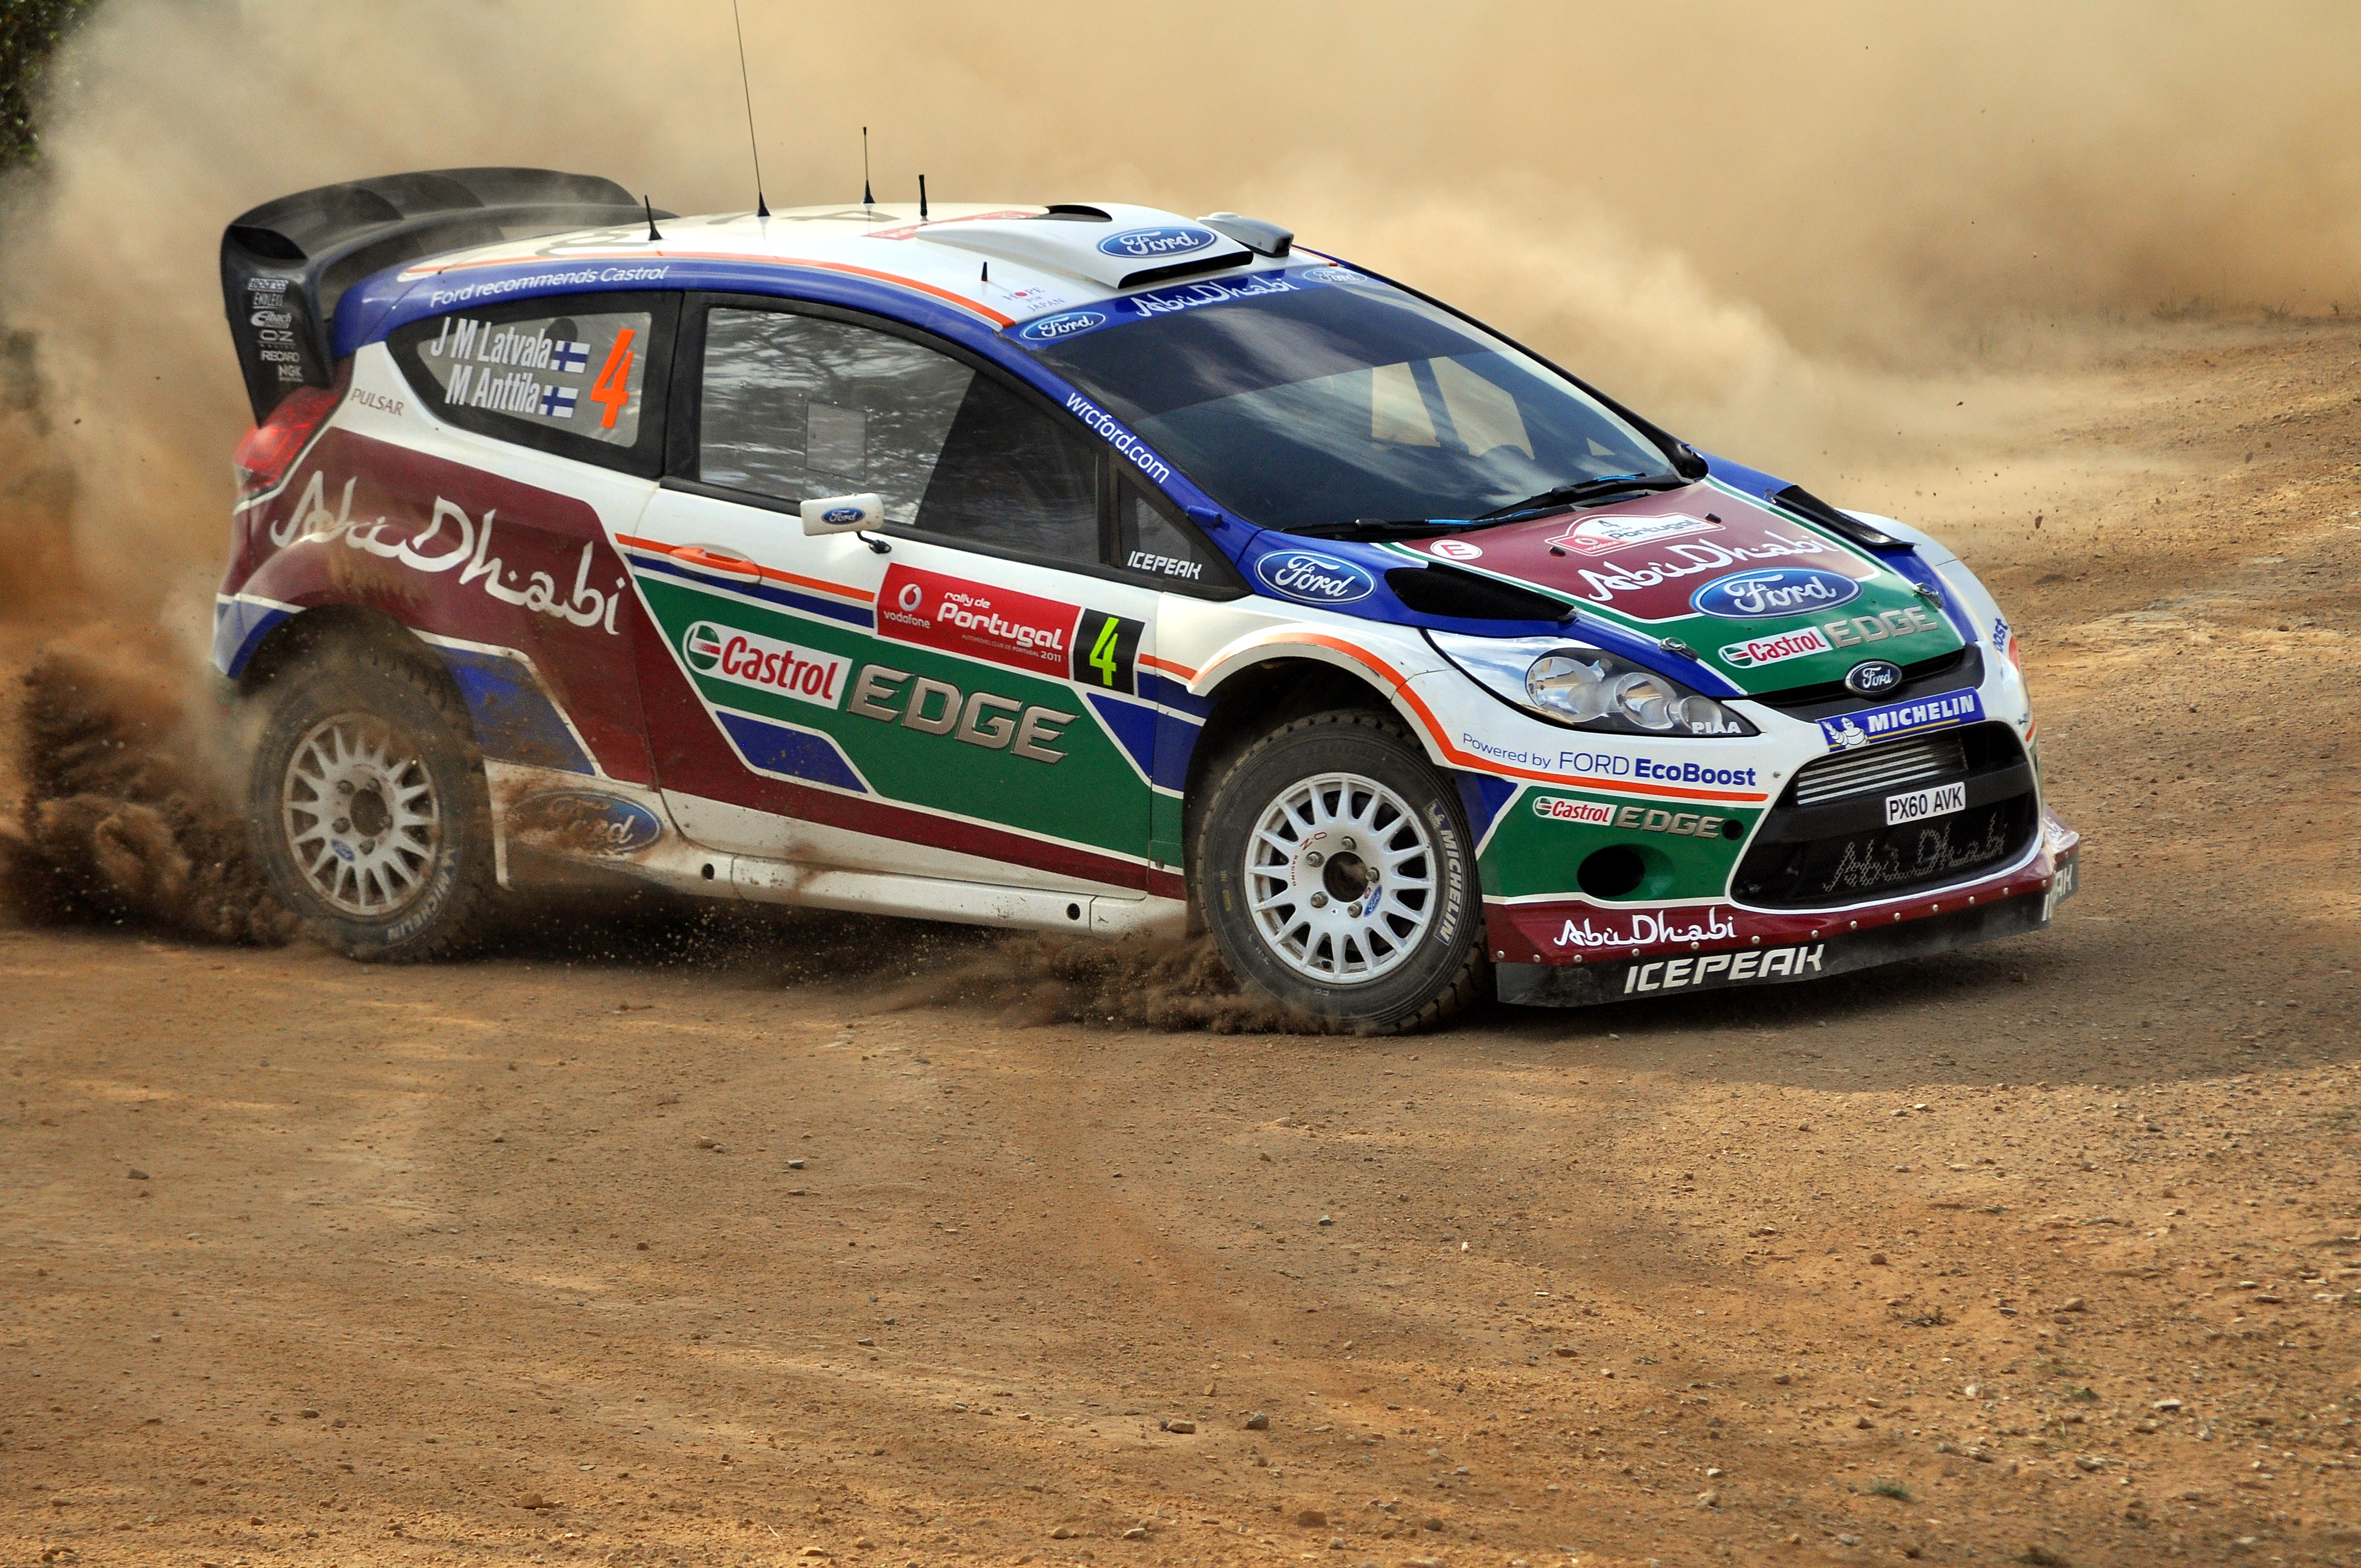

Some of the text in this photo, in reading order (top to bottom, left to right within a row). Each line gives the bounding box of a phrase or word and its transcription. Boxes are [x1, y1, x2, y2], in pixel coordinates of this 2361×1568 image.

[1118, 230, 1199, 255] Ford
[430, 265, 670, 308] Ford recommends Castrol
[1028, 297, 1065, 312] JAPAN
[431, 317, 553, 370] J M Latvala
[1037, 315, 1095, 337] Ford
[444, 363, 542, 414] M Anttila
[590, 328, 635, 429] 4
[350, 388, 405, 417] PULSAR
[1065, 392, 1170, 484] wrcford.com
[1598, 520, 1621, 528] 4
[1608, 519, 1702, 540] Portugal
[269, 470, 621, 636] Abu Dhabi
[1127, 550, 1204, 581] ICEPEAK
[1577, 530, 1840, 602] Abu Dhabi
[1275, 554, 1353, 598] Ford
[1723, 573, 1837, 613] Ford
[883, 610, 931, 630] vodafone
[944, 591, 992, 609] rally de
[937, 602, 1064, 651] Portugal
[1748, 606, 1939, 662] Castrol EDGE
[1040, 650, 1062, 663] 2011
[1088, 616, 1120, 688] 4
[1861, 666, 1894, 689] Ford
[722, 635, 1081, 765] Castrol EDGE
[1867, 694, 1976, 733] MICHELIN
[1691, 721, 1742, 734] PIAA
[1462, 733, 1756, 787] Powered by FORD EcoBoost
[1551, 799, 1727, 839] Castrol EDGE
[1888, 786, 1964, 822] PX60 AVK
[1440, 829, 1462, 942] MICHELIN
[1553, 906, 1739, 948] Abu Dhabi
[1623, 943, 1825, 994] ICEPEAK
